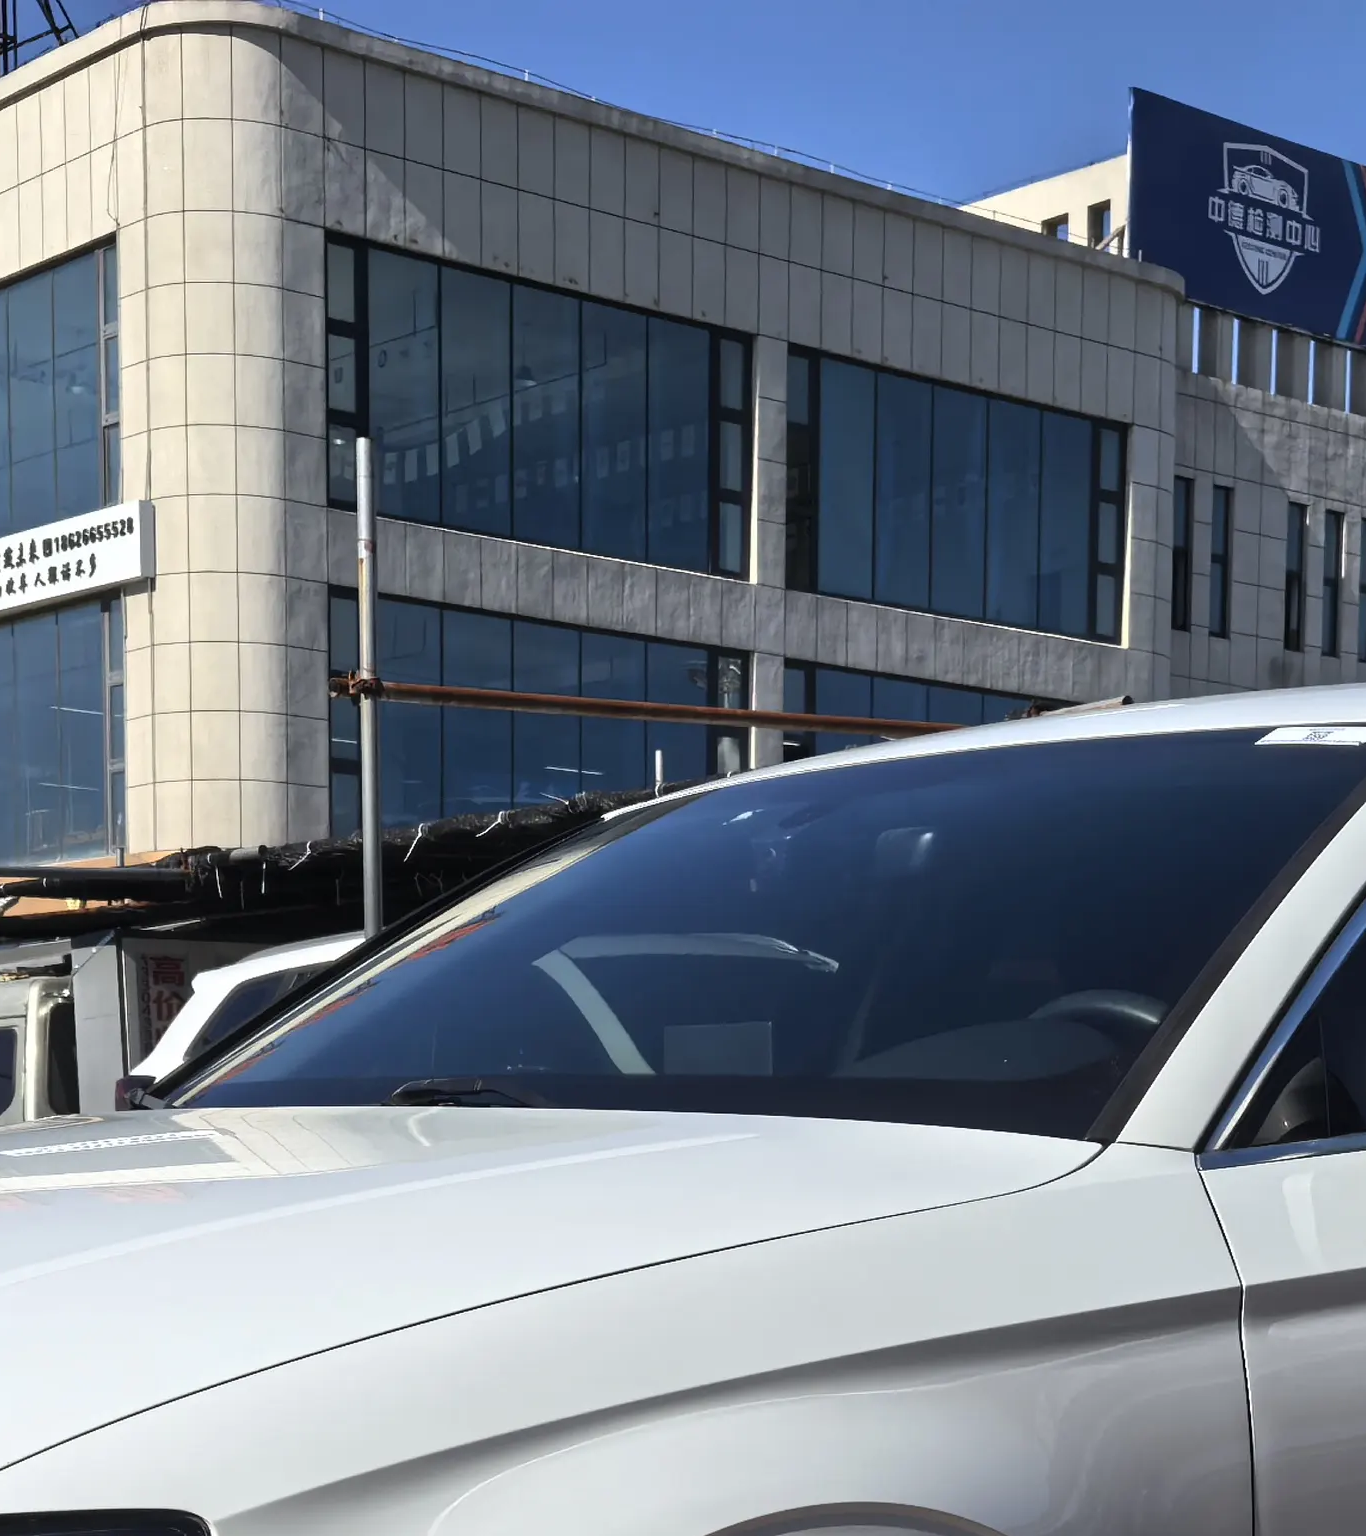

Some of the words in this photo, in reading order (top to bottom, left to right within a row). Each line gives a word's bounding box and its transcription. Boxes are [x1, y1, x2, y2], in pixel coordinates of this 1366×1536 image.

[1208, 196, 1321, 253] 中德检测中心
